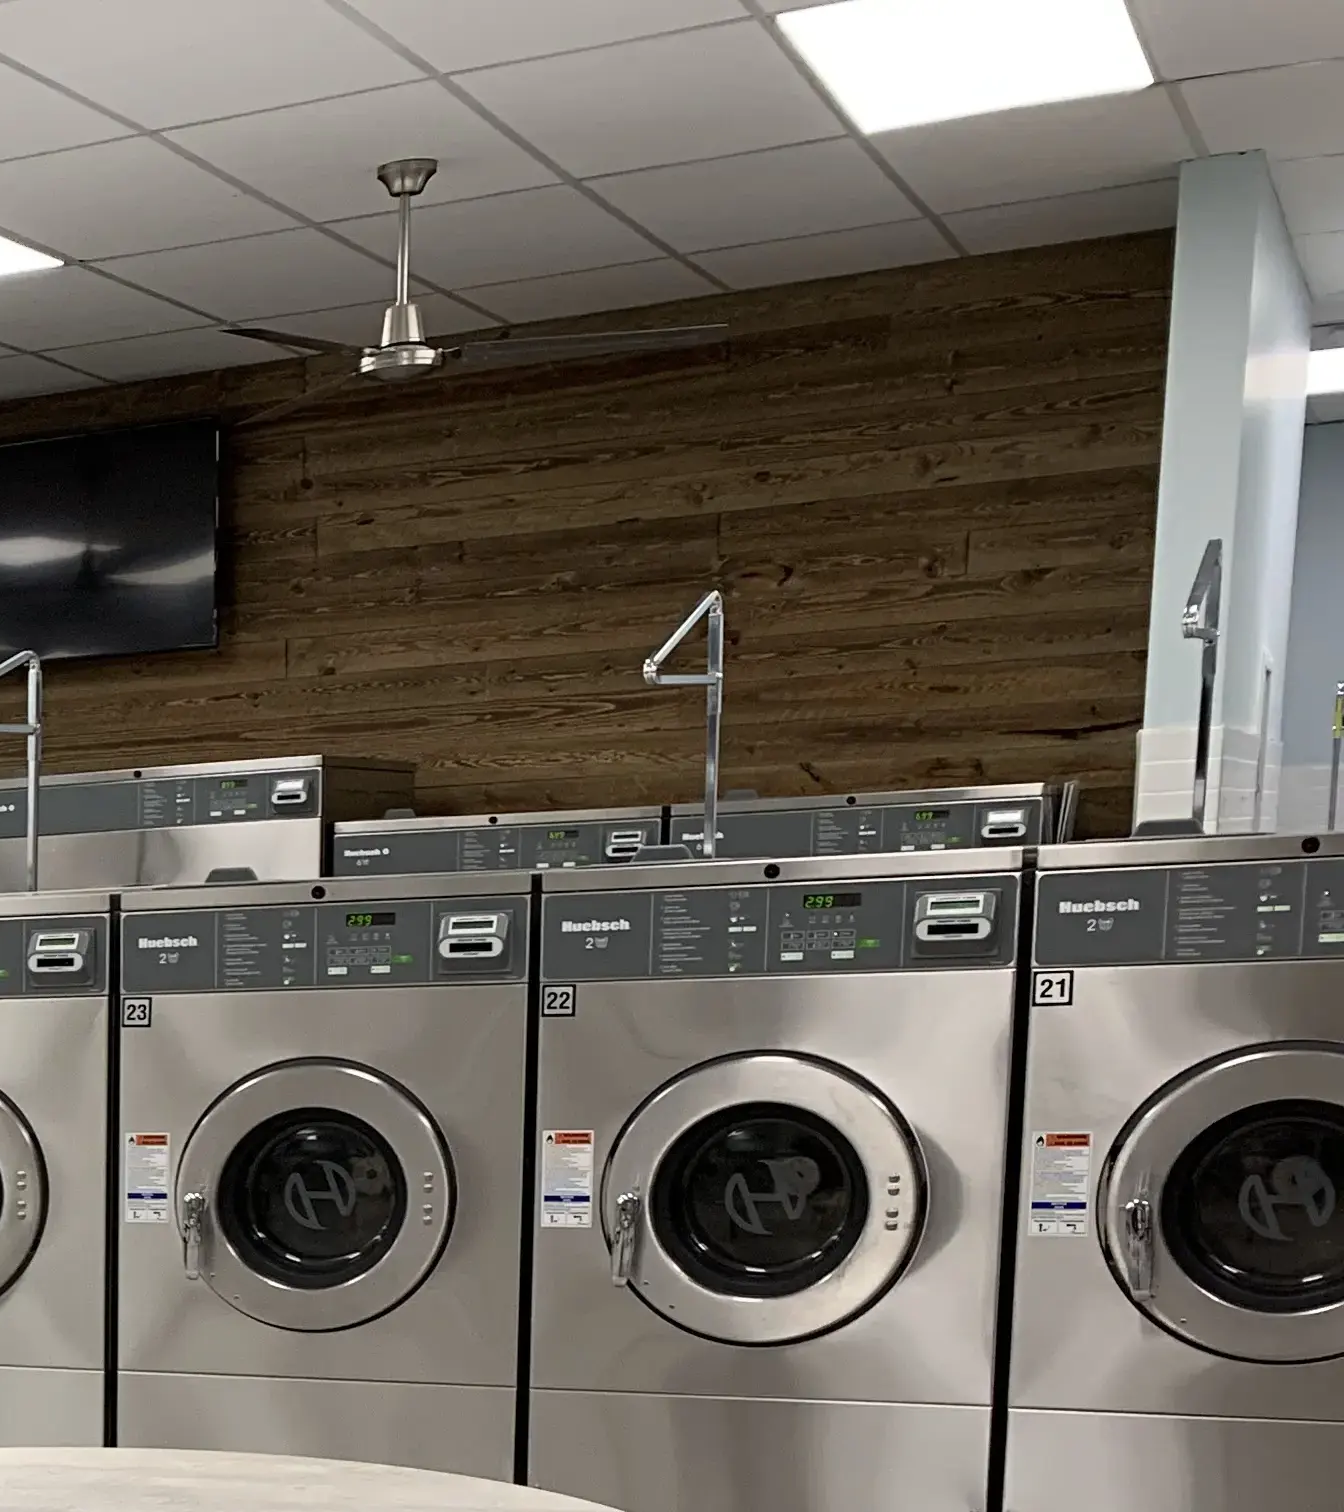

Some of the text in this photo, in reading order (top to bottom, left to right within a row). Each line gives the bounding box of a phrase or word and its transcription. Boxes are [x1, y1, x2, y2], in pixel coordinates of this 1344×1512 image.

[804, 896, 834, 908] 299
[1059, 899, 1140, 914] Huebsch
[347, 915, 373, 927] 299
[561, 919, 631, 932] Huebsch
[1086, 919, 1096, 932] 2
[138, 936, 199, 949] Huebsch
[585, 937, 594, 949] 2
[159, 953, 167, 964] 2
[1040, 978, 1066, 998] 21
[546, 991, 570, 1010] 22
[126, 1004, 147, 1021] 23
